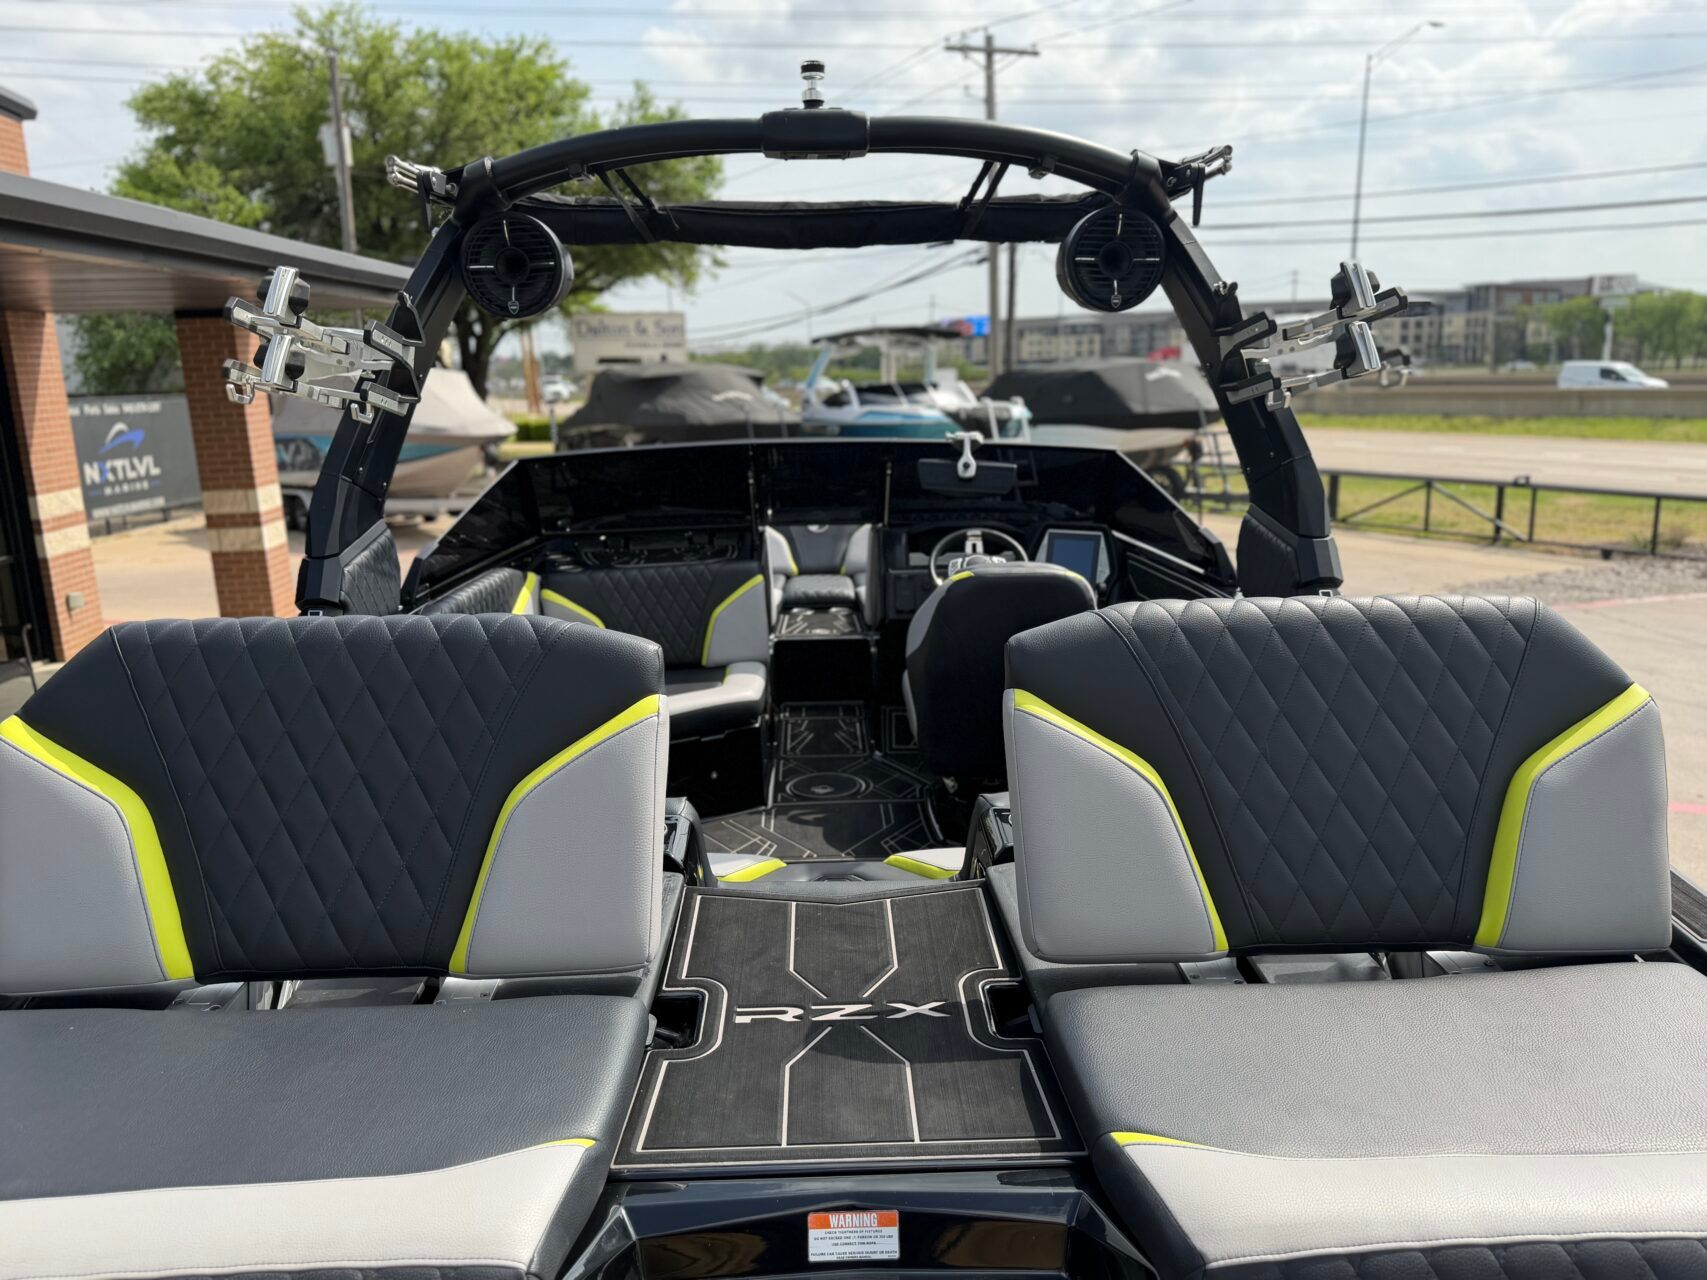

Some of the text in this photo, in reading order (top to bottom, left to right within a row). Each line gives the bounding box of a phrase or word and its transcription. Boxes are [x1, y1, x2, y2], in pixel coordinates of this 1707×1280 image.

[634, 319, 649, 336] &
[83, 455, 161, 486] NXTLVL
[734, 1001, 951, 1024] RZX
[829, 1213, 878, 1228] WARNING
